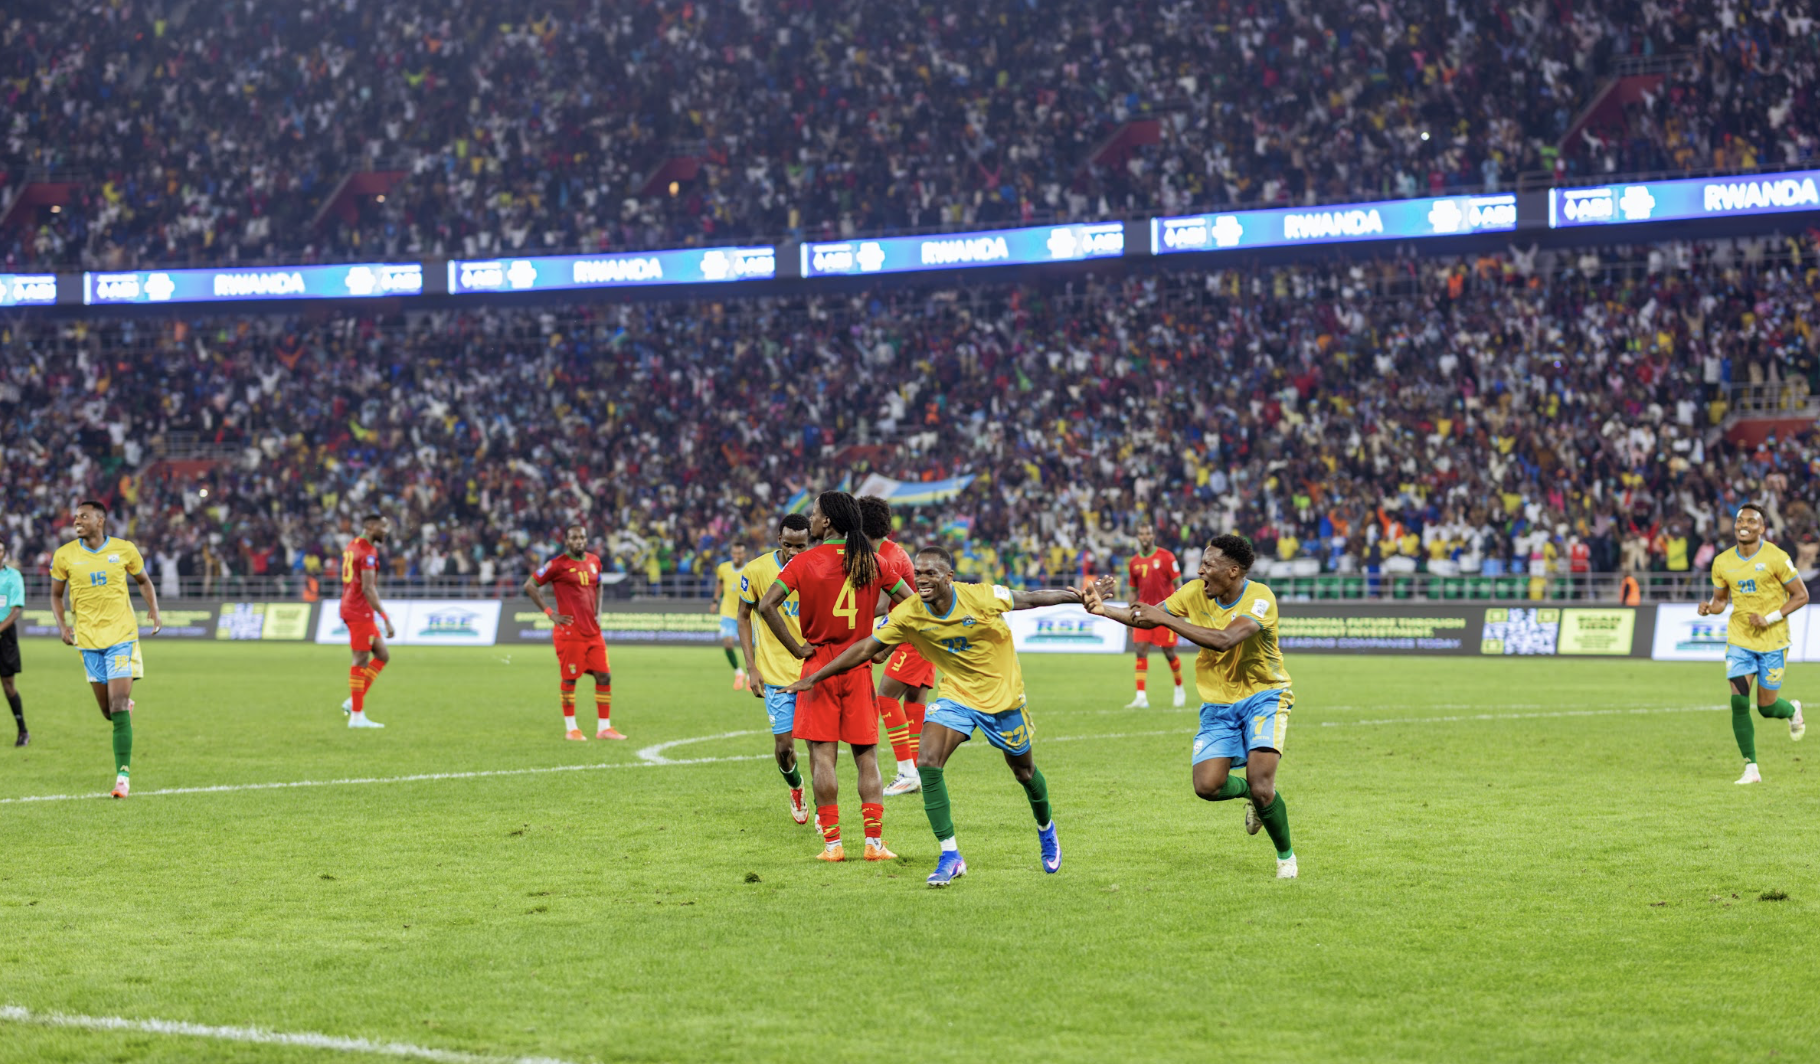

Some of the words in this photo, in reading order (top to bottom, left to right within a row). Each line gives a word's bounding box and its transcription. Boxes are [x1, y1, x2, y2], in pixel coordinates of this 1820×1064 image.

[1704, 178, 1819, 211] RWANDA
[1284, 209, 1384, 239] RWANDA
[921, 236, 1009, 265] RWANDA
[573, 258, 663, 284] RWANDA
[213, 272, 306, 296] RWANDA
[90, 571, 107, 587] 15
[578, 571, 589, 586] 11
[832, 575, 859, 630] 4
[1037, 619, 1094, 632] RSE
[941, 636, 973, 653] 22
[893, 651, 908, 669] 3
[1000, 724, 1028, 747] 22
[1253, 715, 1268, 735] 7
